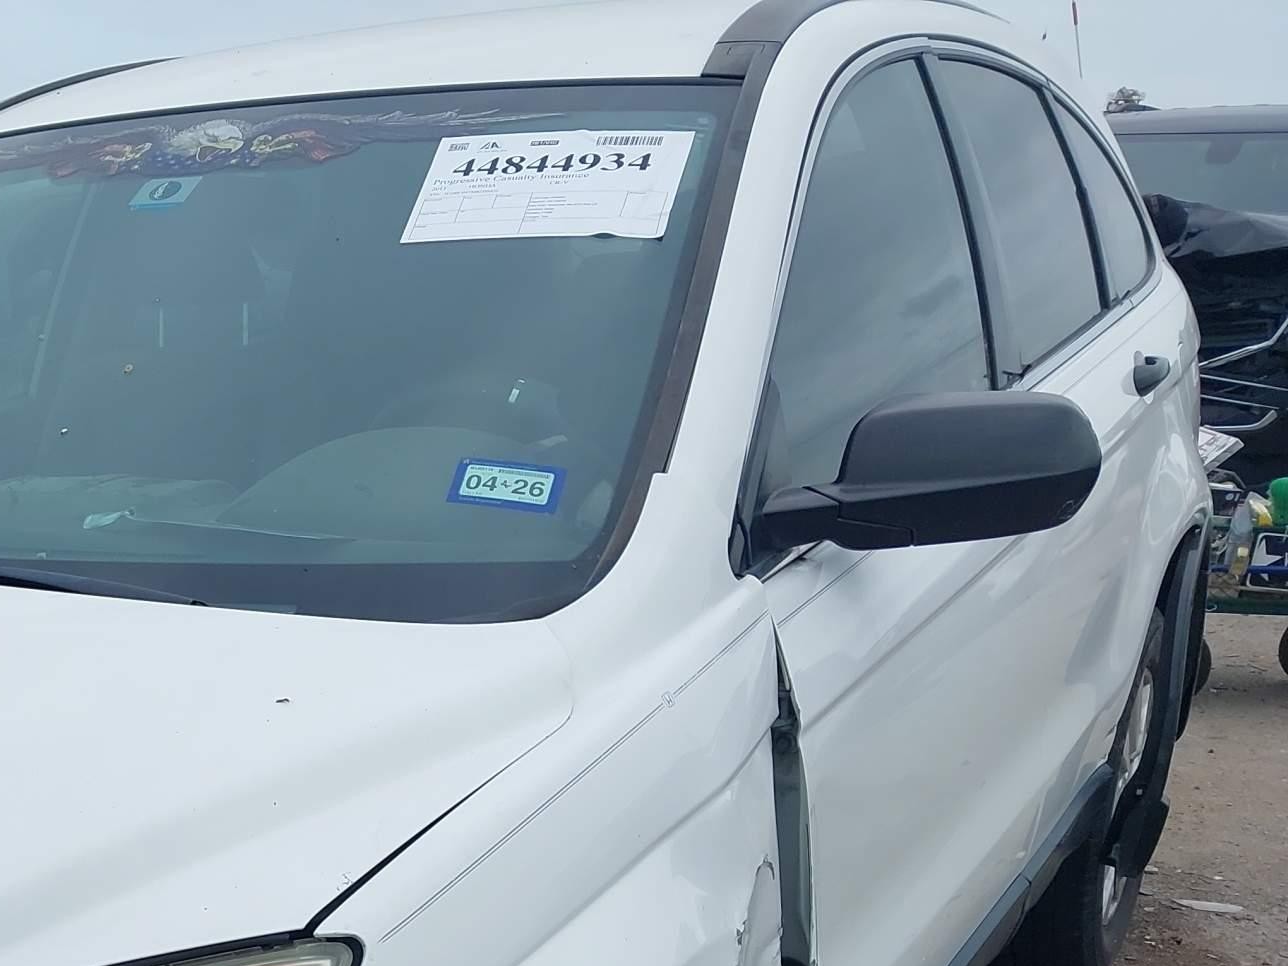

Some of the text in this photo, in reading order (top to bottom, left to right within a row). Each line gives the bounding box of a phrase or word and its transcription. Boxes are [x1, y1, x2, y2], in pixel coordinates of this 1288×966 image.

[452, 152, 652, 177] 44844934
[433, 177, 491, 186] Progressive
[465, 474, 546, 497] 04 26
